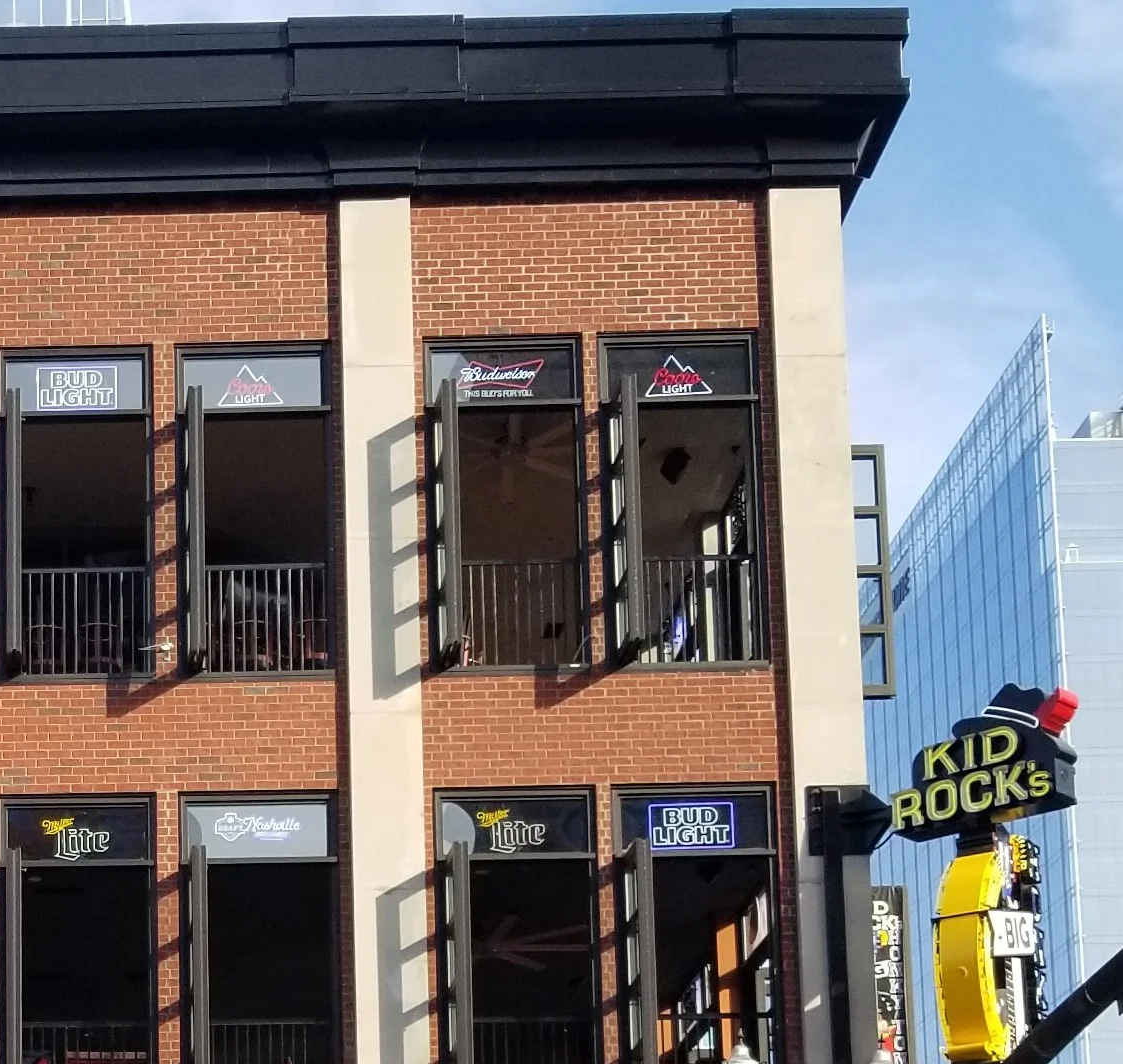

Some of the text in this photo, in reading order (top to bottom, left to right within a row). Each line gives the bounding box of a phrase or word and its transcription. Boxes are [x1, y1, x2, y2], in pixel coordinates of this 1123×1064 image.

[51, 370, 103, 388] BUD
[460, 367, 536, 382] Budweiser
[41, 388, 113, 406] LIGHT
[662, 383, 693, 393] LIGHT
[236, 394, 265, 403] LIGHT
[922, 725, 1019, 781] KID
[890, 760, 1053, 829] ROCK's
[243, 815, 300, 832] Nashville
[663, 808, 718, 827] BUD
[54, 829, 112, 861] Lite
[489, 820, 545, 853] Lite
[653, 826, 730, 845] LIGHT
[1005, 917, 1031, 949] BIG
